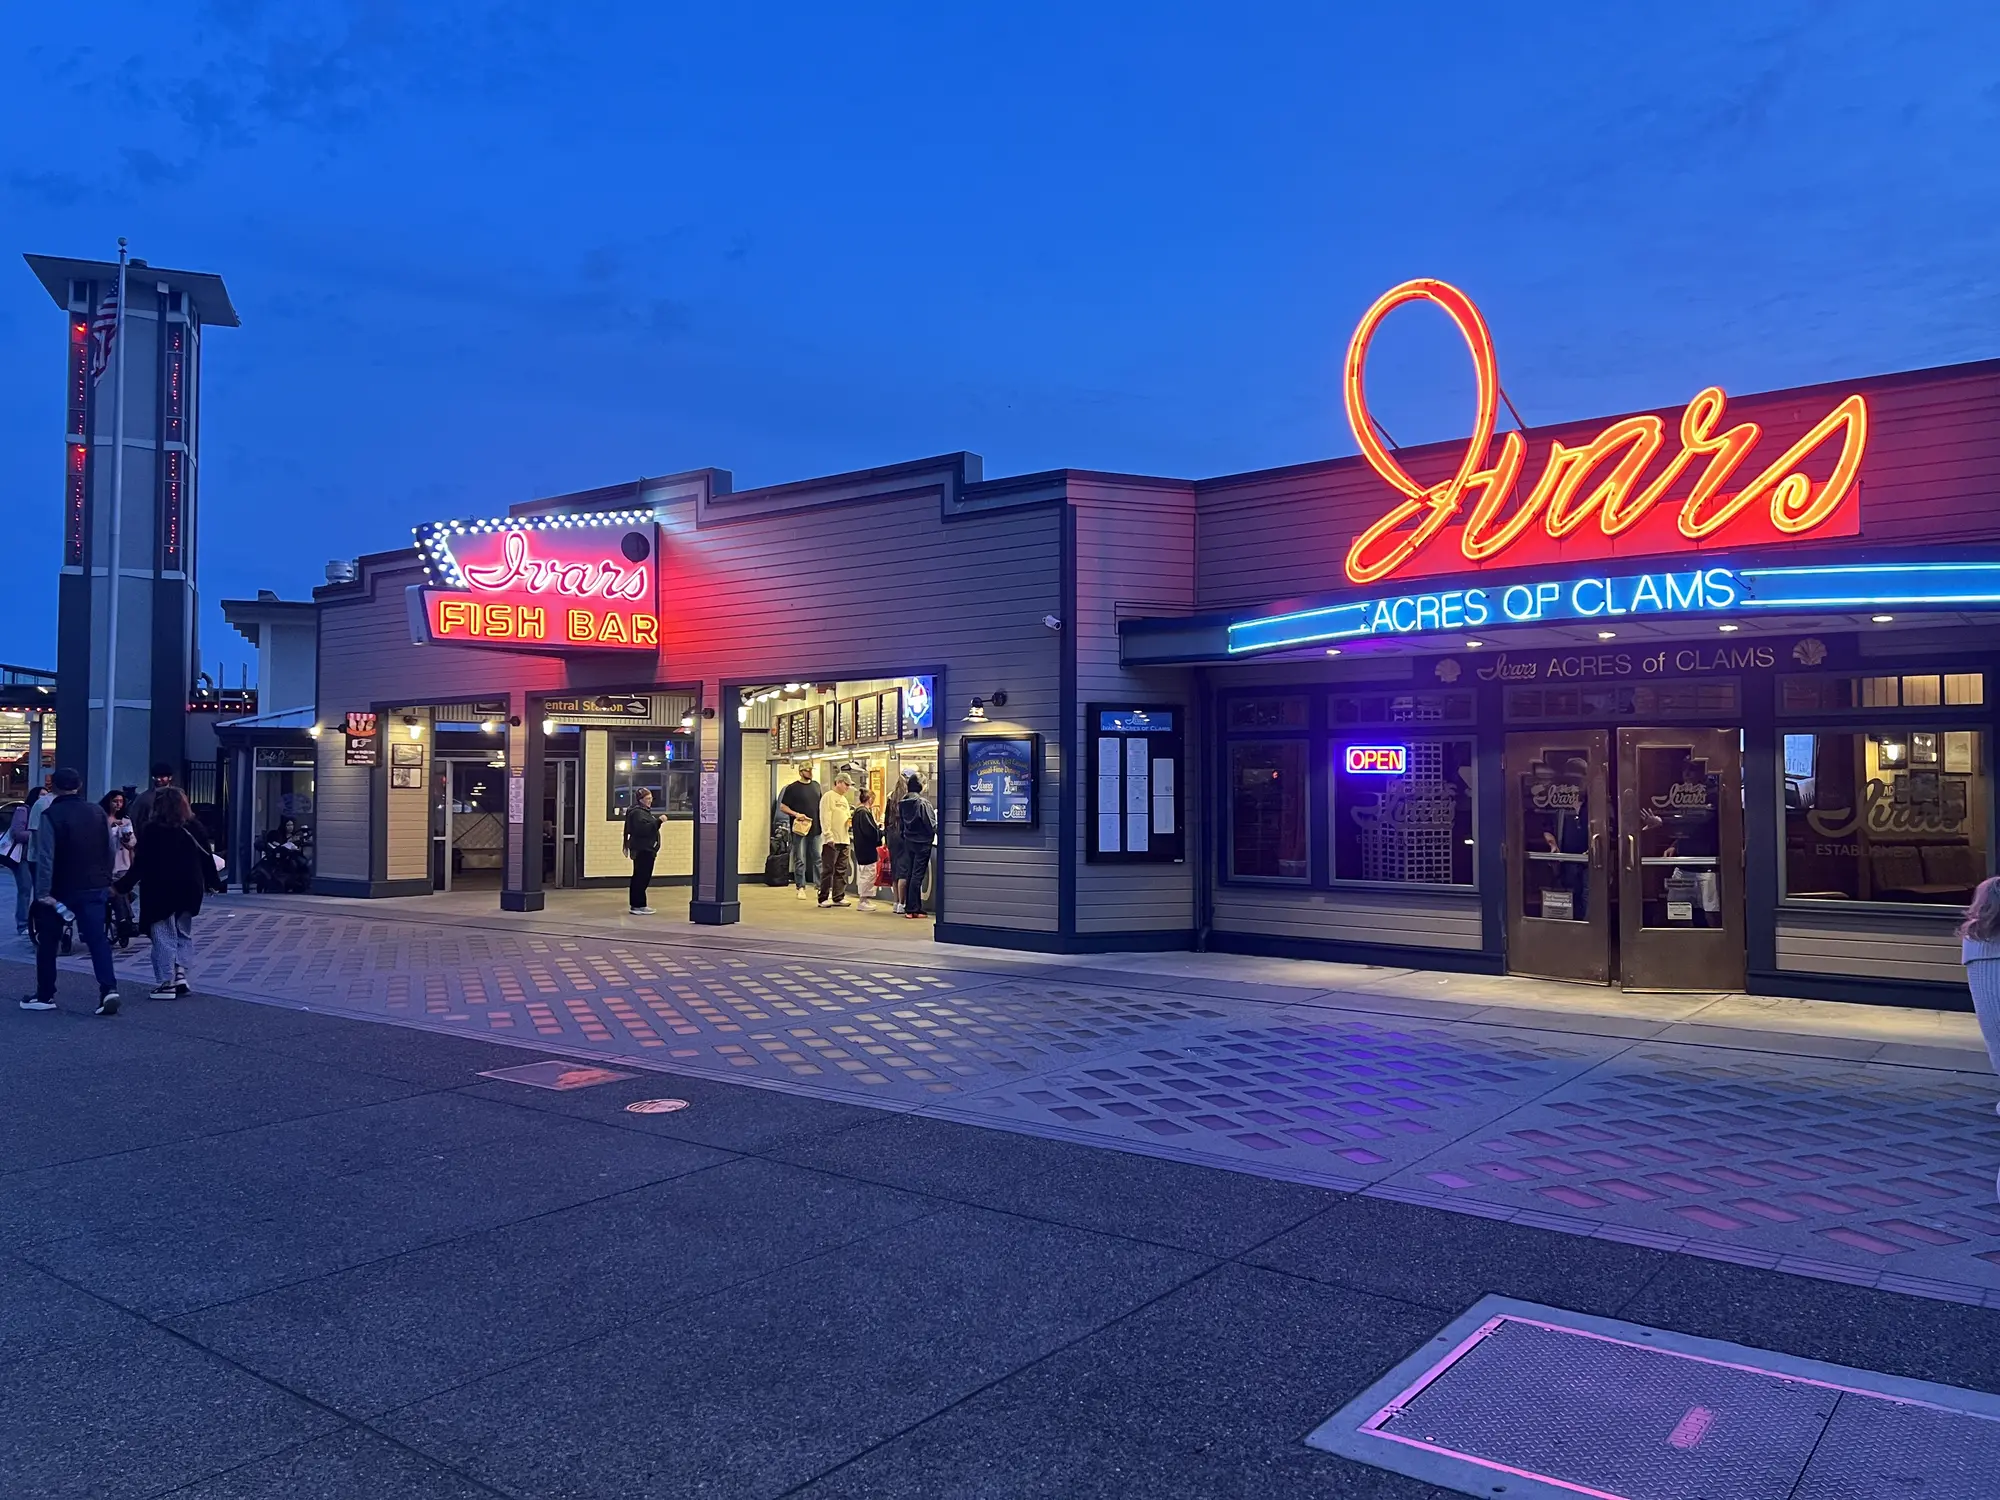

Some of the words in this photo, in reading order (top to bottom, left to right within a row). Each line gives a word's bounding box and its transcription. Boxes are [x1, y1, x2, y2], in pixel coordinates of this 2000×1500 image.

[1373, 588, 1488, 633] ACRES
[1572, 568, 1735, 615] CLAMS
[438, 600, 545, 639] FISH
[567, 607, 659, 645] BAR
[1546, 653, 1632, 679] ACRES
[1642, 651, 1666, 673] of
[1676, 646, 1776, 671] CLAMS
[544, 699, 579, 712] entral
[583, 700, 624, 713] Staon
[1350, 750, 1403, 770] OPEN
